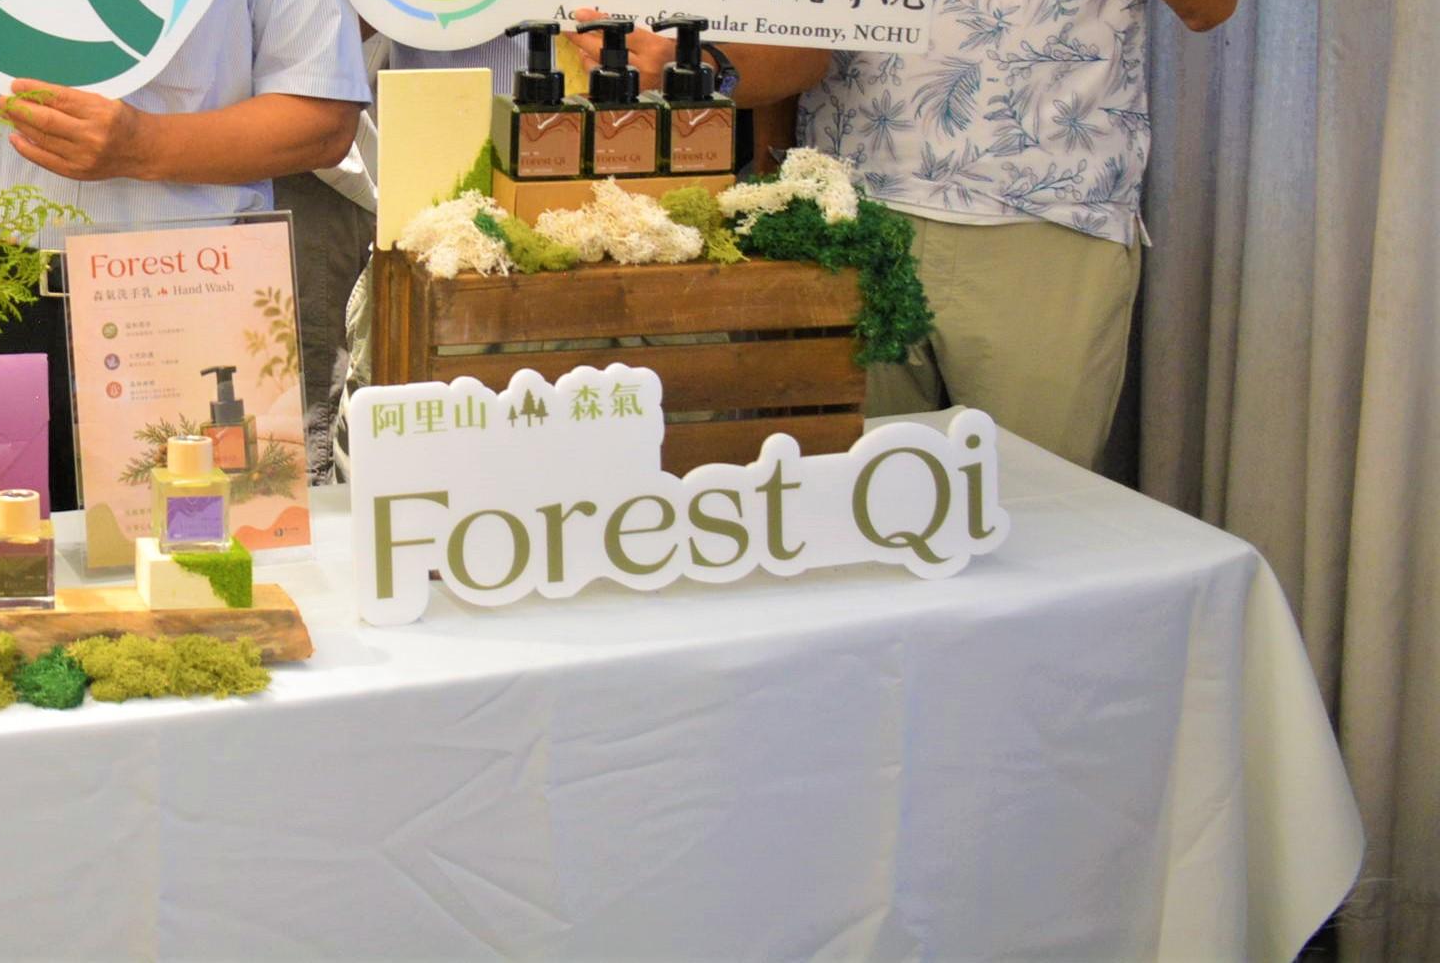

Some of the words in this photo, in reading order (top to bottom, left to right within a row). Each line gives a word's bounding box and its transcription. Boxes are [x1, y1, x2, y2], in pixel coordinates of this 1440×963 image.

[755, 18, 847, 42] Economy,
[852, 23, 921, 45] NCHU
[90, 250, 188, 279] Forest
[196, 244, 232, 275] Qi
[173, 283, 203, 297] Hand
[205, 280, 235, 294] Wash
[371, 395, 487, 438] 阿里山
[568, 382, 644, 421] 森氣
[372, 458, 806, 600] Forest
[851, 433, 996, 565] Qi
